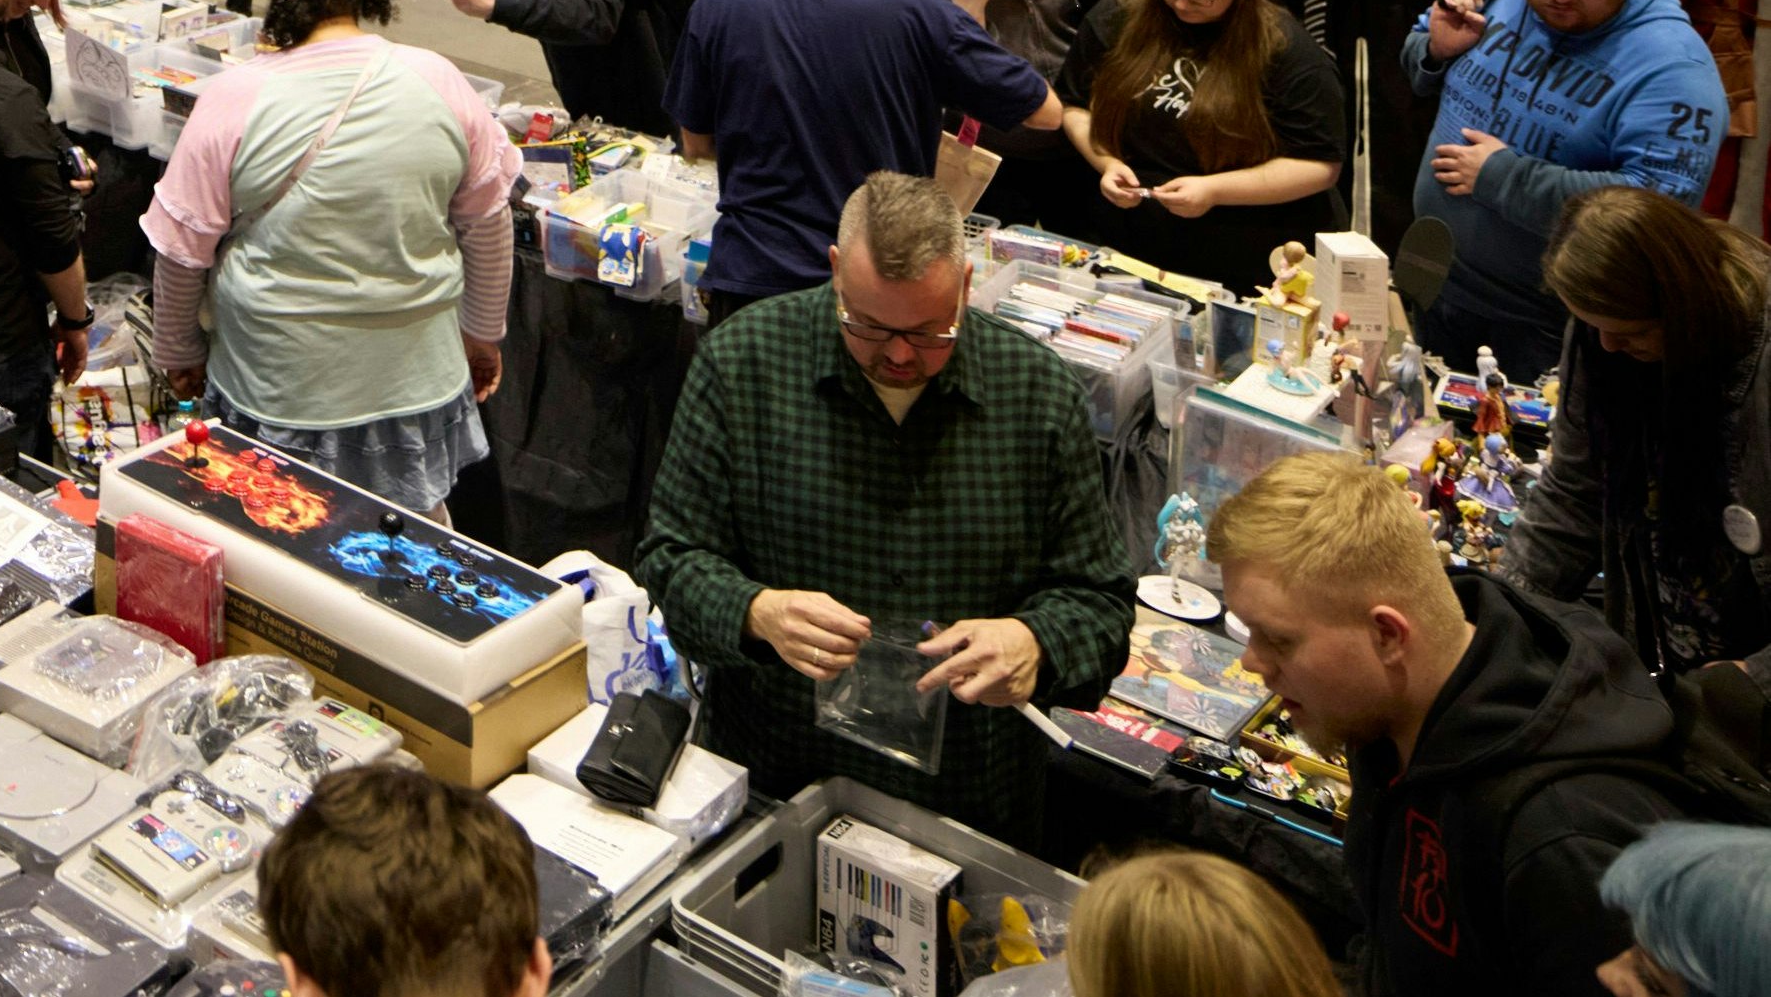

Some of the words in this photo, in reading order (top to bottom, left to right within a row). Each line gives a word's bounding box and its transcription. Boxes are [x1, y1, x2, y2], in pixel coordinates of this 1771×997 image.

[1667, 102, 1713, 144] 25
[227, 595, 259, 620] rcade
[260, 609, 297, 638] Games
[299, 629, 339, 659] Station
[821, 918, 834, 952] N64
